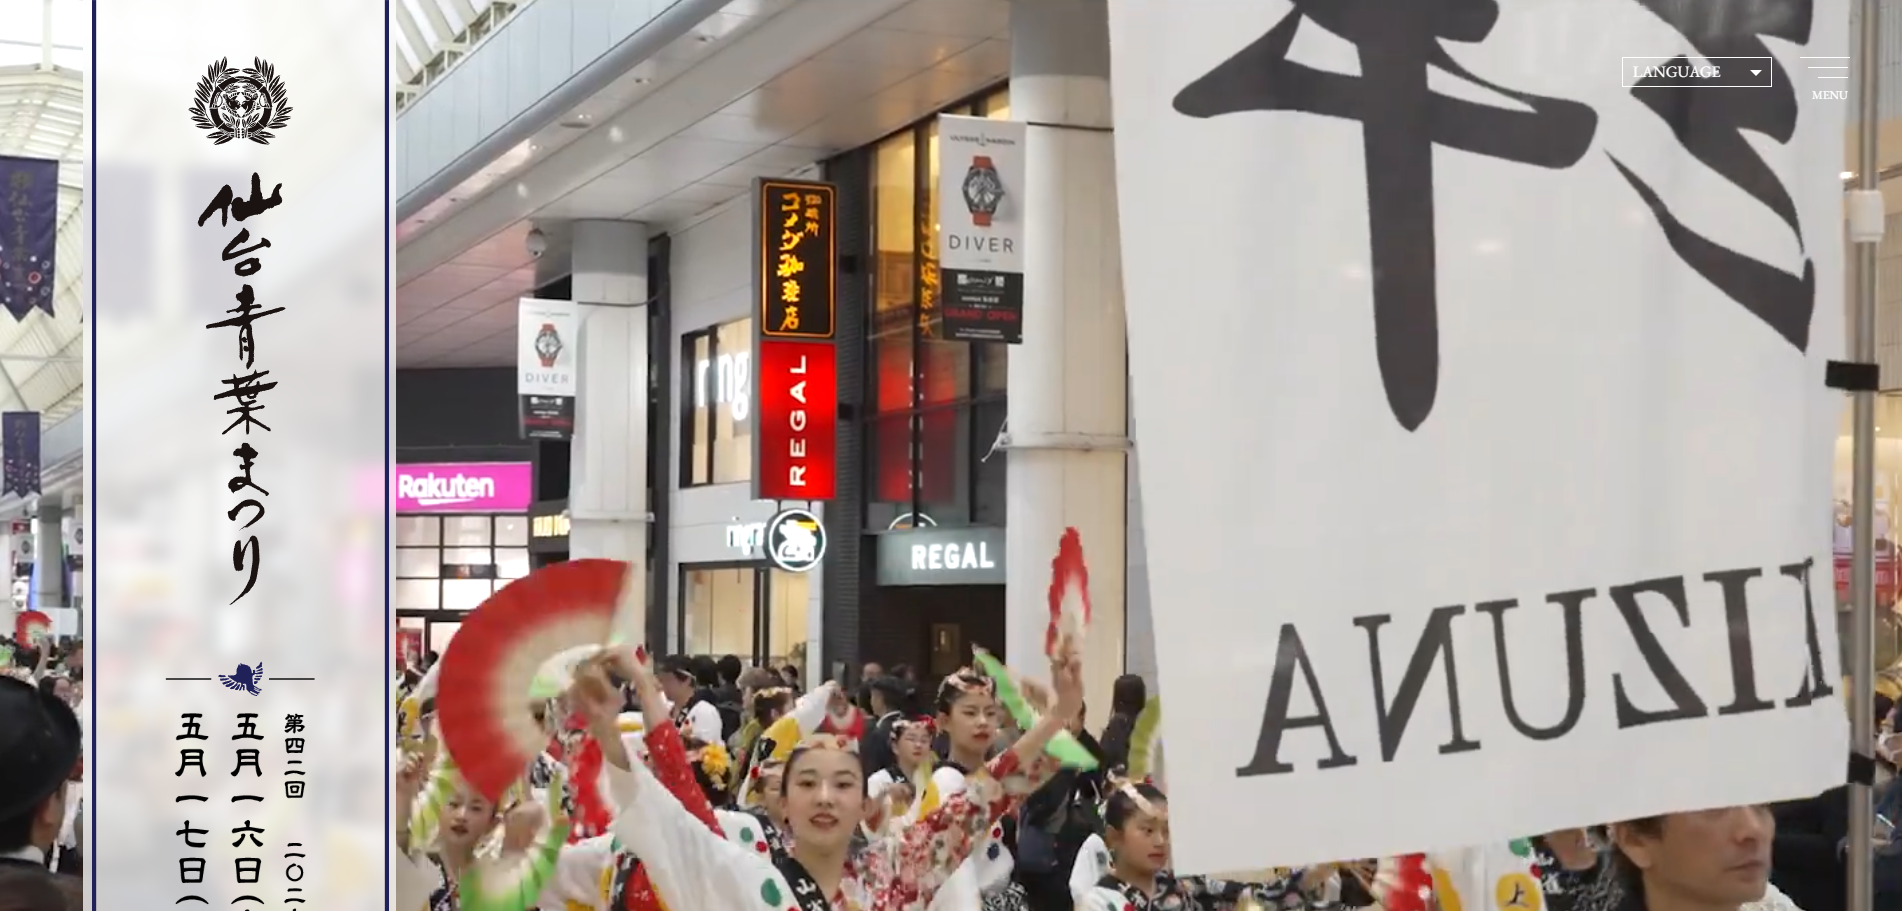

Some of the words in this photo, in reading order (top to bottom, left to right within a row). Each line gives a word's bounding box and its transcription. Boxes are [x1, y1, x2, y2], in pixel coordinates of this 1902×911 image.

[949, 234, 1015, 254] DIVER
[525, 372, 569, 384] DIVER
[789, 354, 807, 487] REGAL
[398, 472, 495, 500] Rakuten
[911, 541, 995, 570] REGAL
